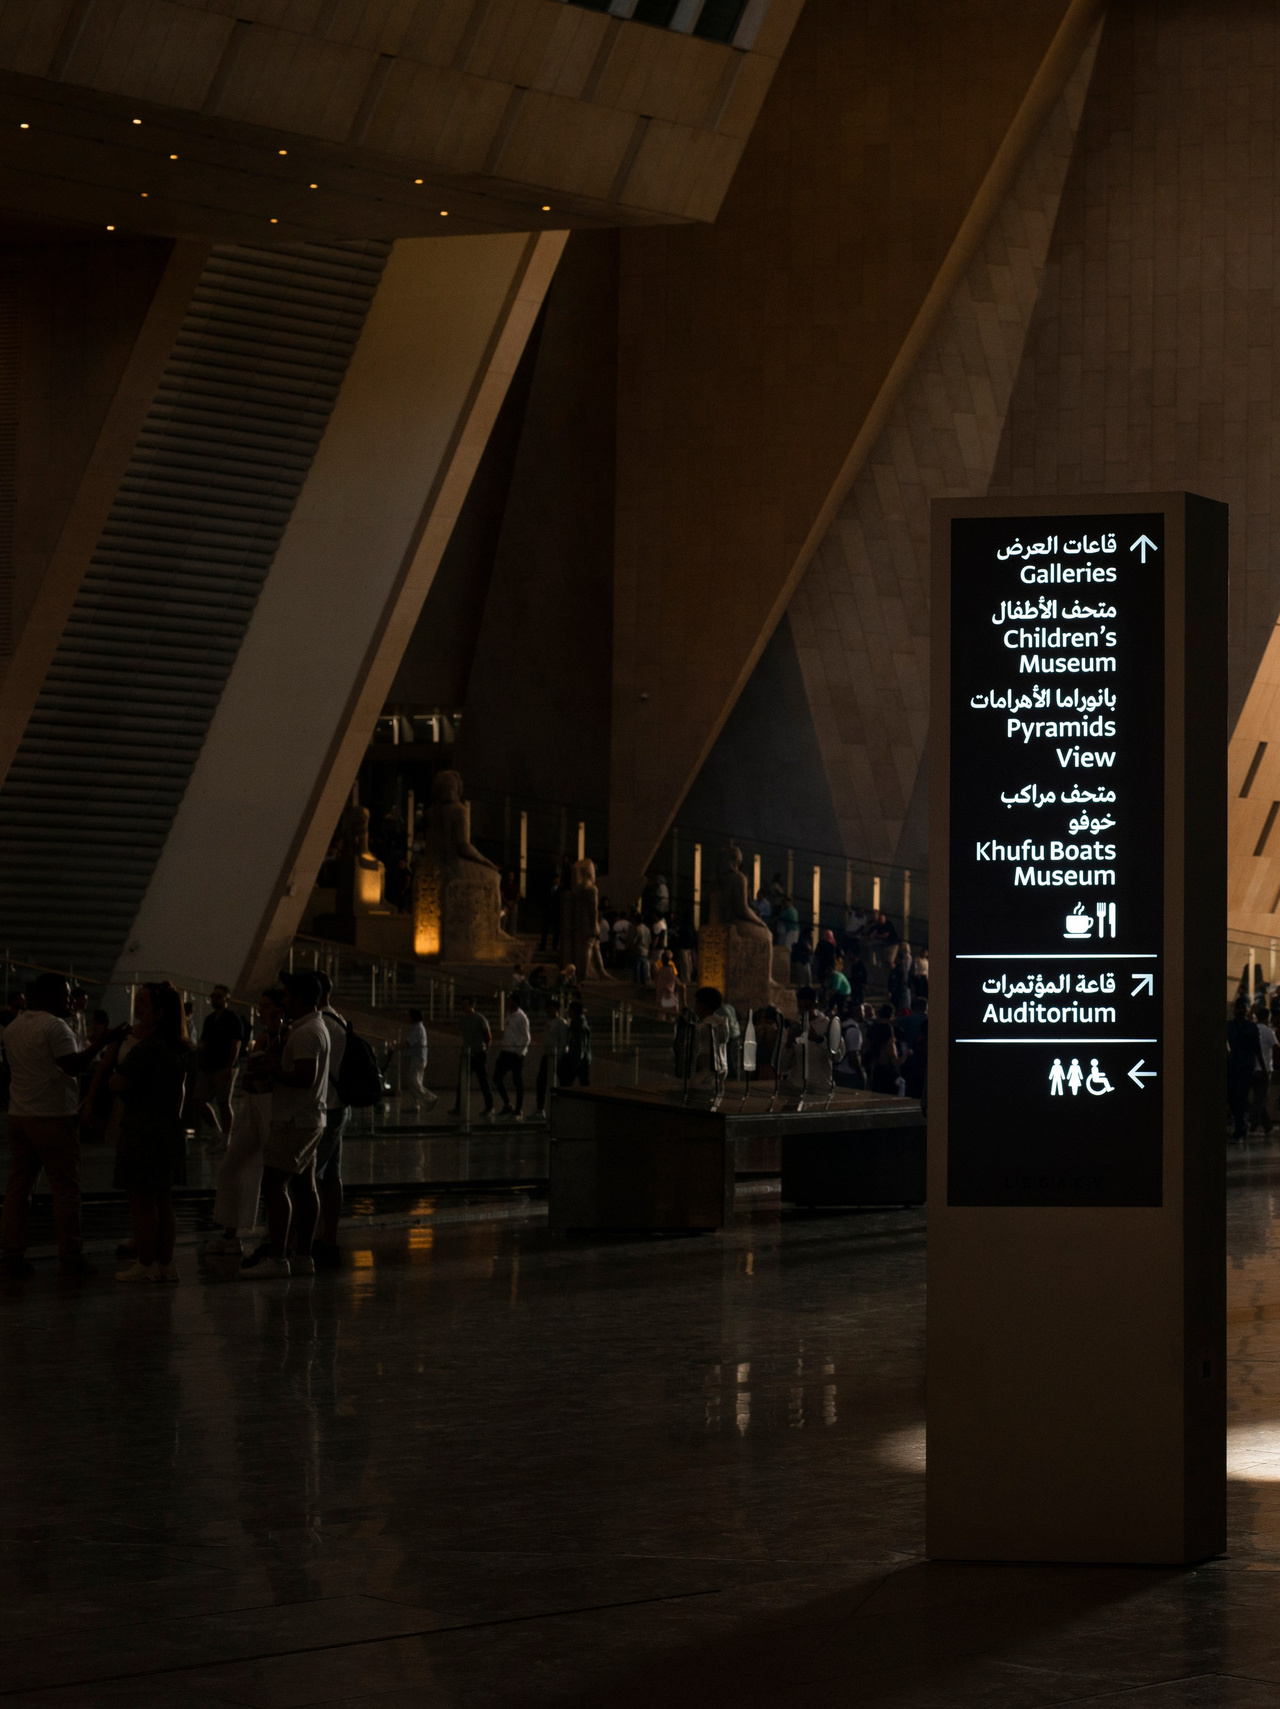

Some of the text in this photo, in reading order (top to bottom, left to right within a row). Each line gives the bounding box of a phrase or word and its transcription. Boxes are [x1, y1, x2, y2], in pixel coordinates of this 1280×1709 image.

[996, 532, 1117, 561] قاعات العرض
[1020, 561, 1117, 584] Galleries
[991, 595, 1117, 625] متحف الأطفال
[1003, 625, 1117, 649] Children’s
[1019, 654, 1117, 674] Museum
[970, 684, 1117, 714] بانوراما الأهرامات
[1007, 714, 1117, 744] Pyramids
[1055, 745, 1117, 768] View
[1000, 783, 1117, 810] متحف مراكب
[1068, 809, 1117, 836] خوفو
[976, 838, 1117, 862] Khufu Boats
[1013, 866, 1117, 887] Museum
[981, 972, 1116, 999] قاعة المؤتمرات
[982, 1000, 1116, 1024] Auditorium
